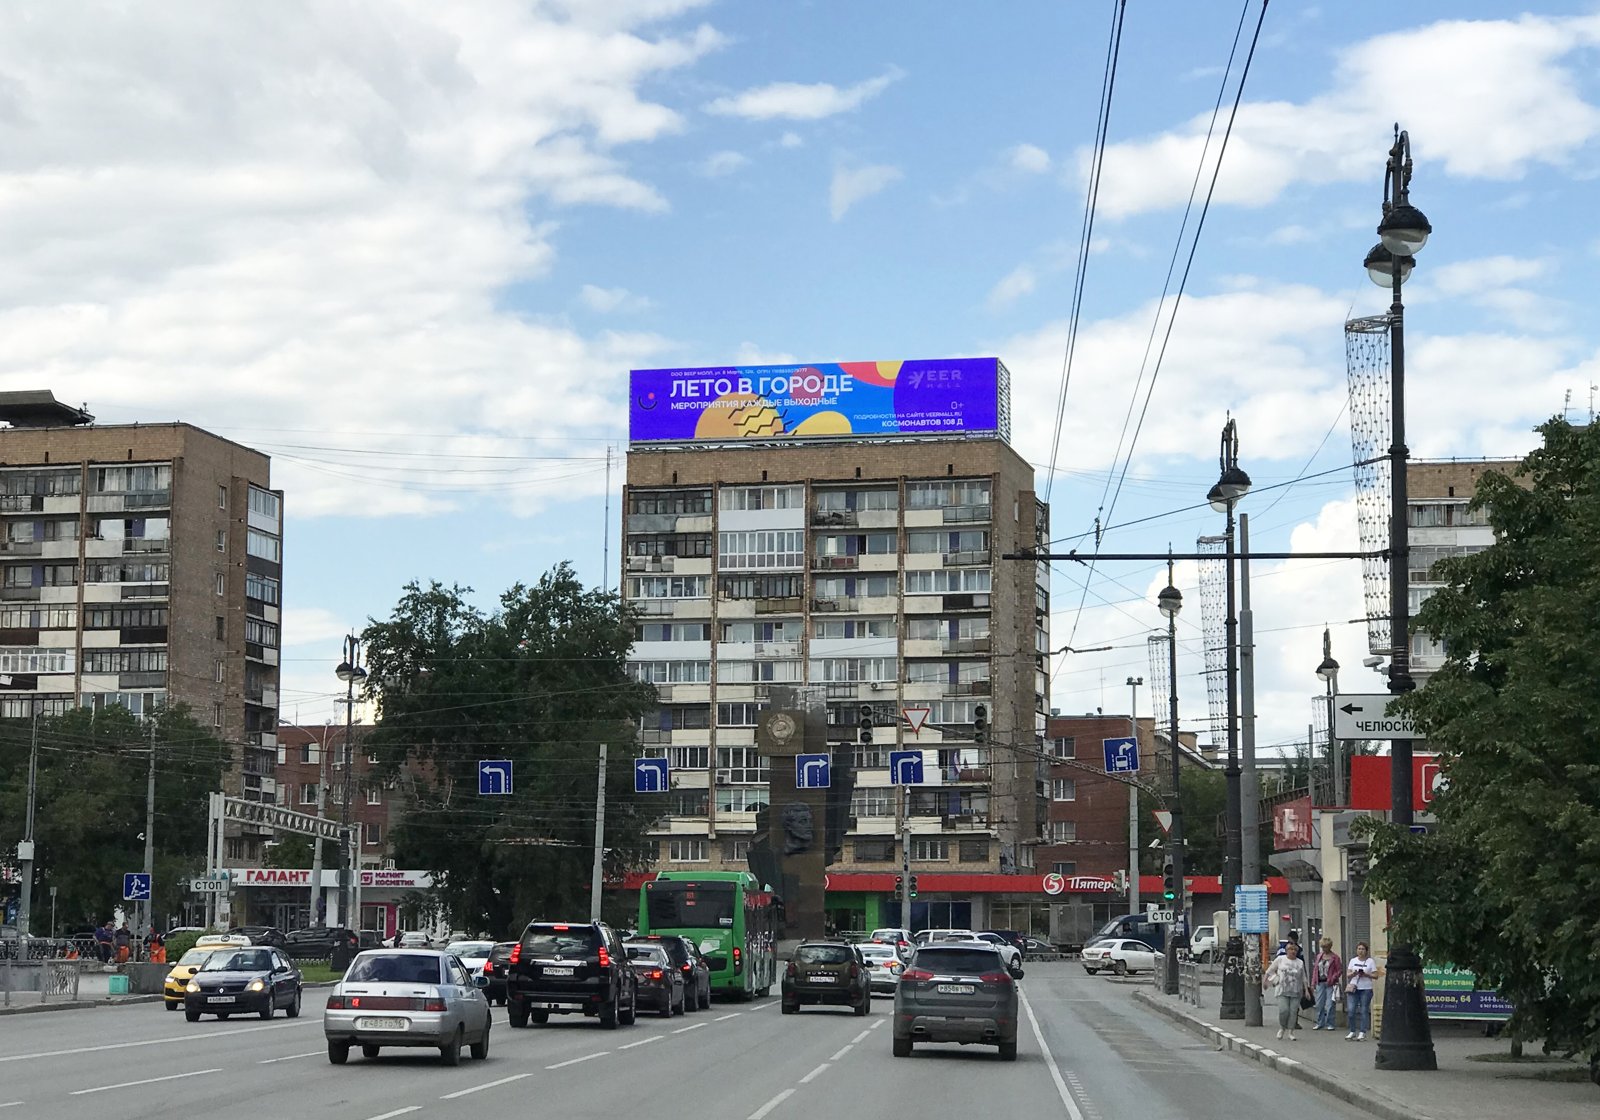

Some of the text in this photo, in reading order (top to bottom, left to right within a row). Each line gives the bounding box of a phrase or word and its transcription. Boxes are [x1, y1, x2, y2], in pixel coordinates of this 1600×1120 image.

[670, 374, 853, 398] ЛЕТО В ГОРОДЕ
[671, 397, 838, 410] МЕРОПРИЯТИЯ КАЖДЫЕ ВЫХОДНЫЕ
[882, 418, 964, 428] КОСМОНАВТОВ 108 Д
[1356, 721, 1416, 732] ЧЕЛЮСКИ
[246, 870, 310, 881] ГАЛАНТ
[195, 881, 222, 891] СТОП
[1460, 995, 1471, 1003] 64
